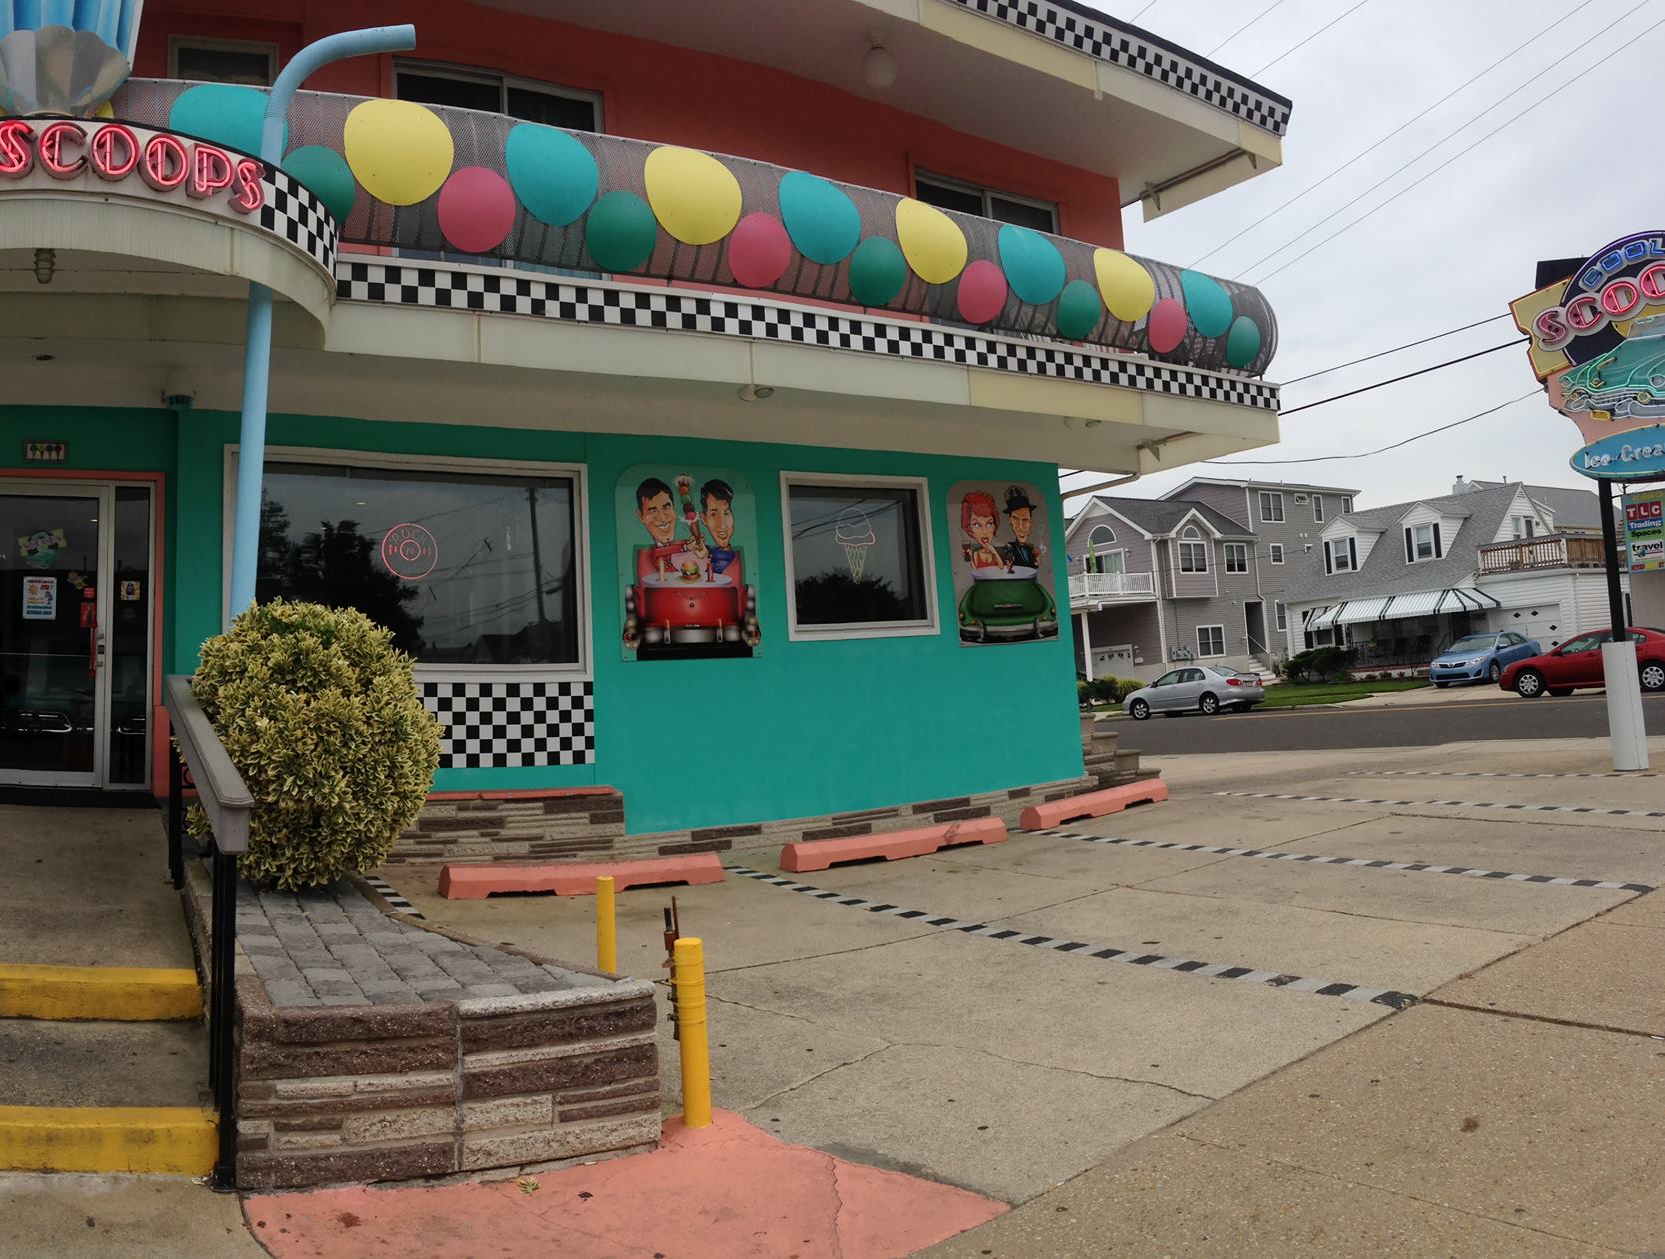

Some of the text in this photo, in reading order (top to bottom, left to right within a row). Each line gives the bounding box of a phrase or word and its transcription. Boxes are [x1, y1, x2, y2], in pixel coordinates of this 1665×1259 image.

[1580, 238, 1665, 289] COOL
[1584, 443, 1665, 469] Ice Crea
[1627, 505, 1661, 518] TLC
[1629, 520, 1662, 529] Trading
[1630, 528, 1662, 539] Spaces
[1632, 541, 1664, 552] travel
